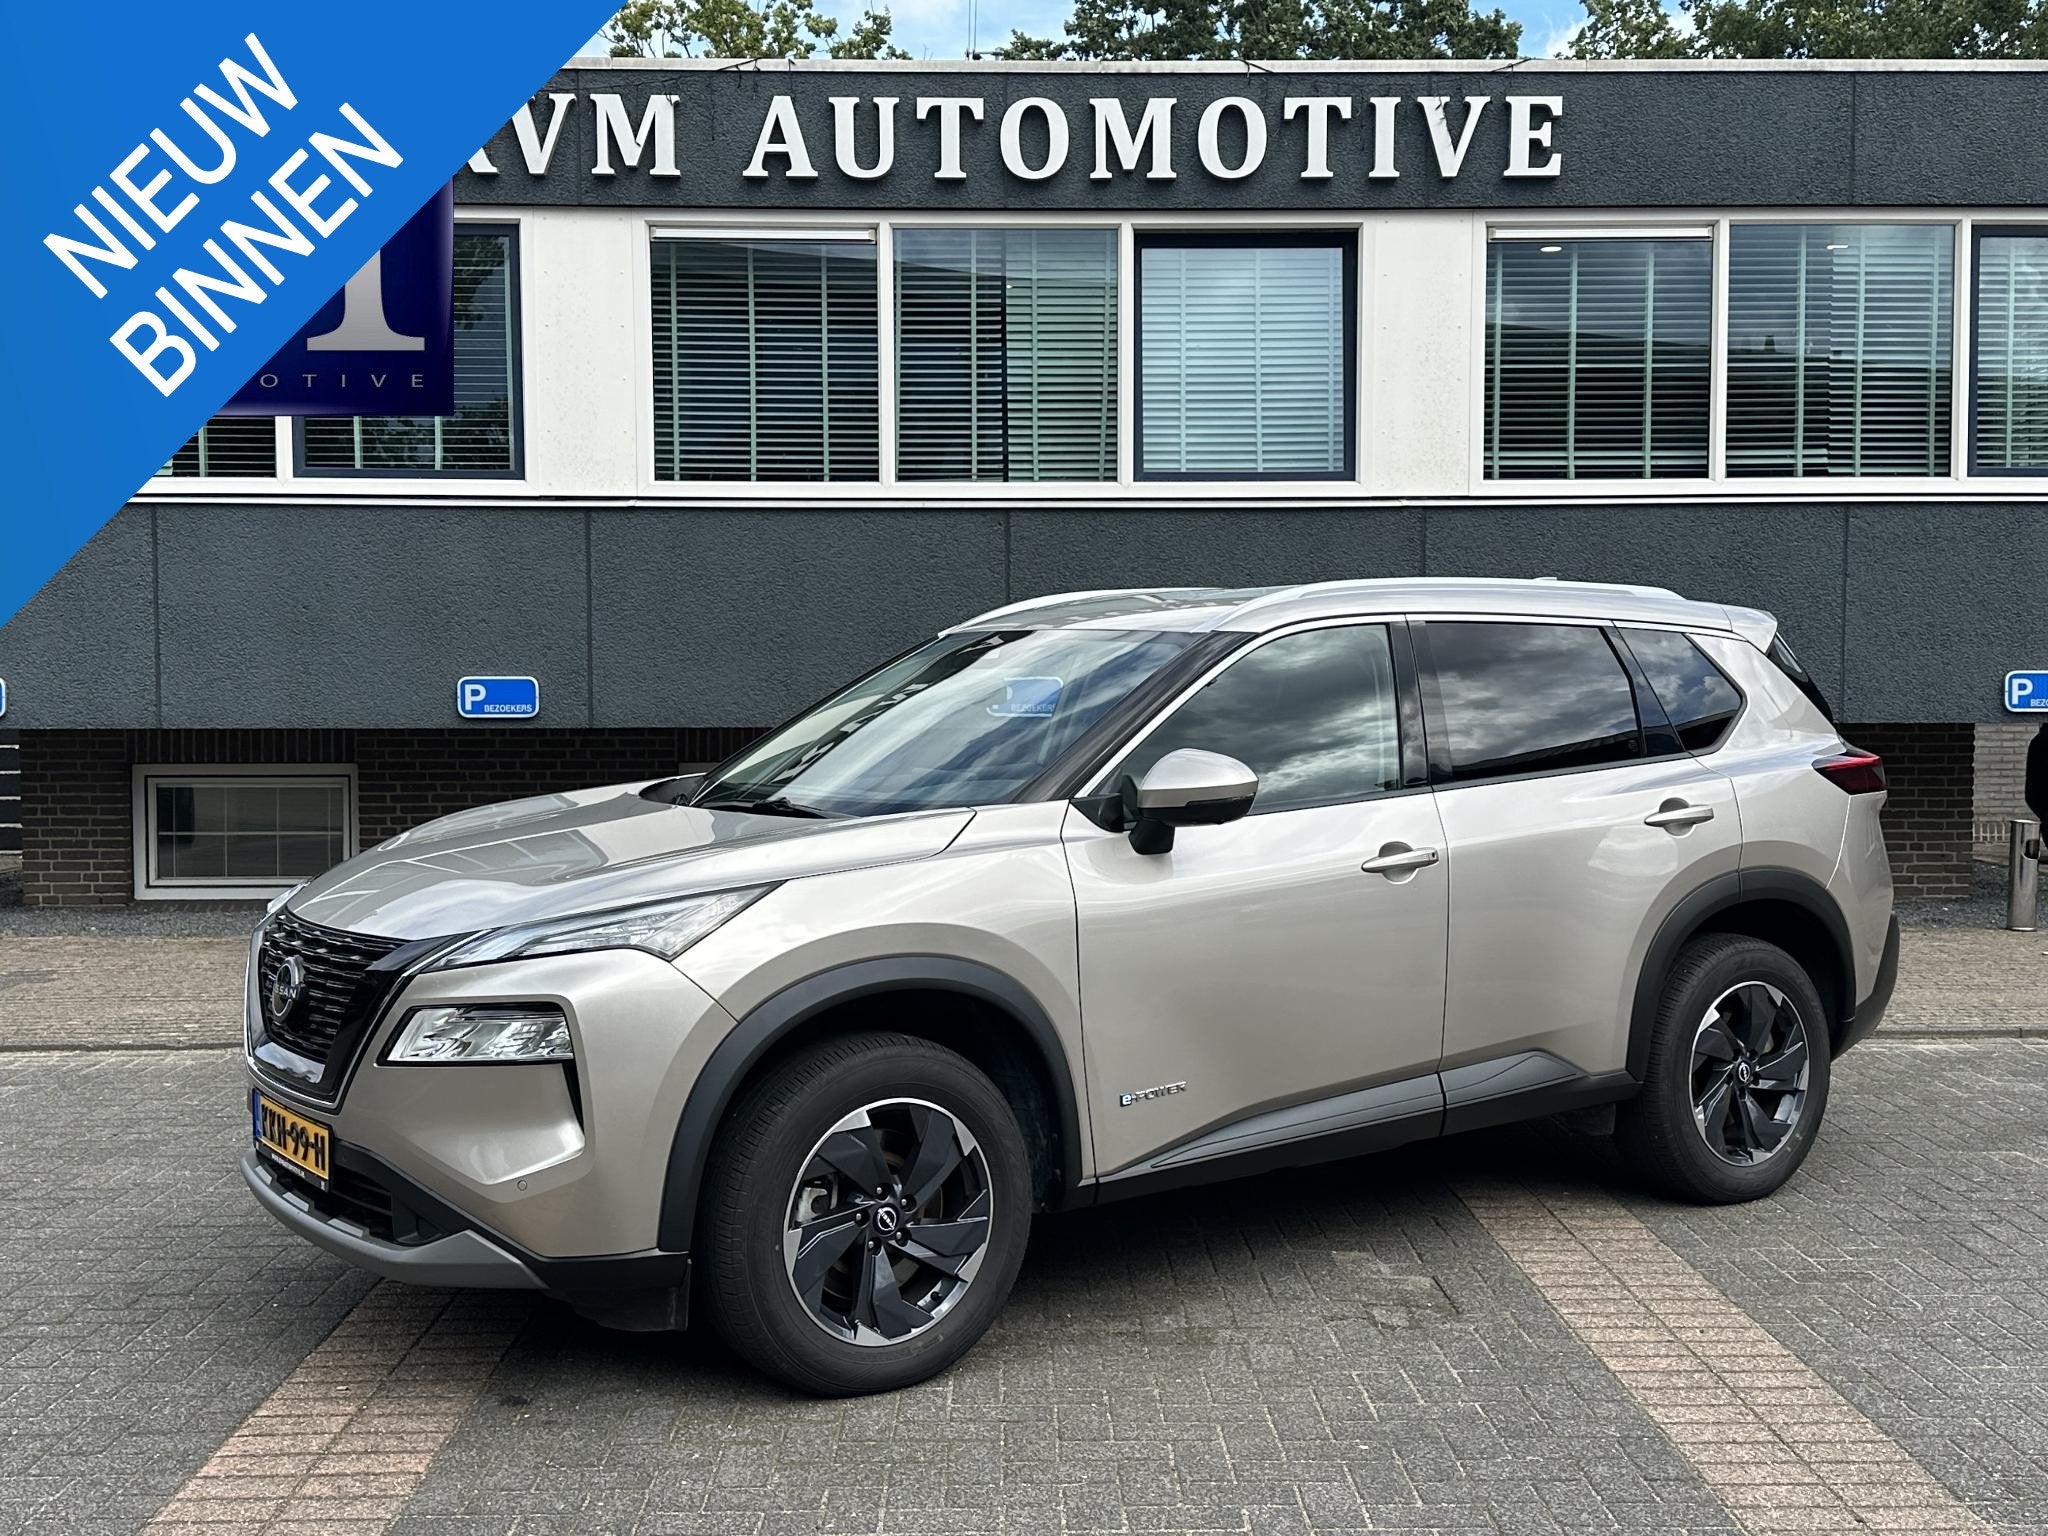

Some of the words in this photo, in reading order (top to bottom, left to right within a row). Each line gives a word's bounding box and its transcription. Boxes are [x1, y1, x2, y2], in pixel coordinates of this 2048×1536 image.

[467, 92, 681, 176] VM
[742, 94, 1564, 181] AUTOMOTIVE
[464, 684, 487, 711] P
[2012, 678, 2034, 705] P
[484, 704, 533, 713] BEZOEKERS
